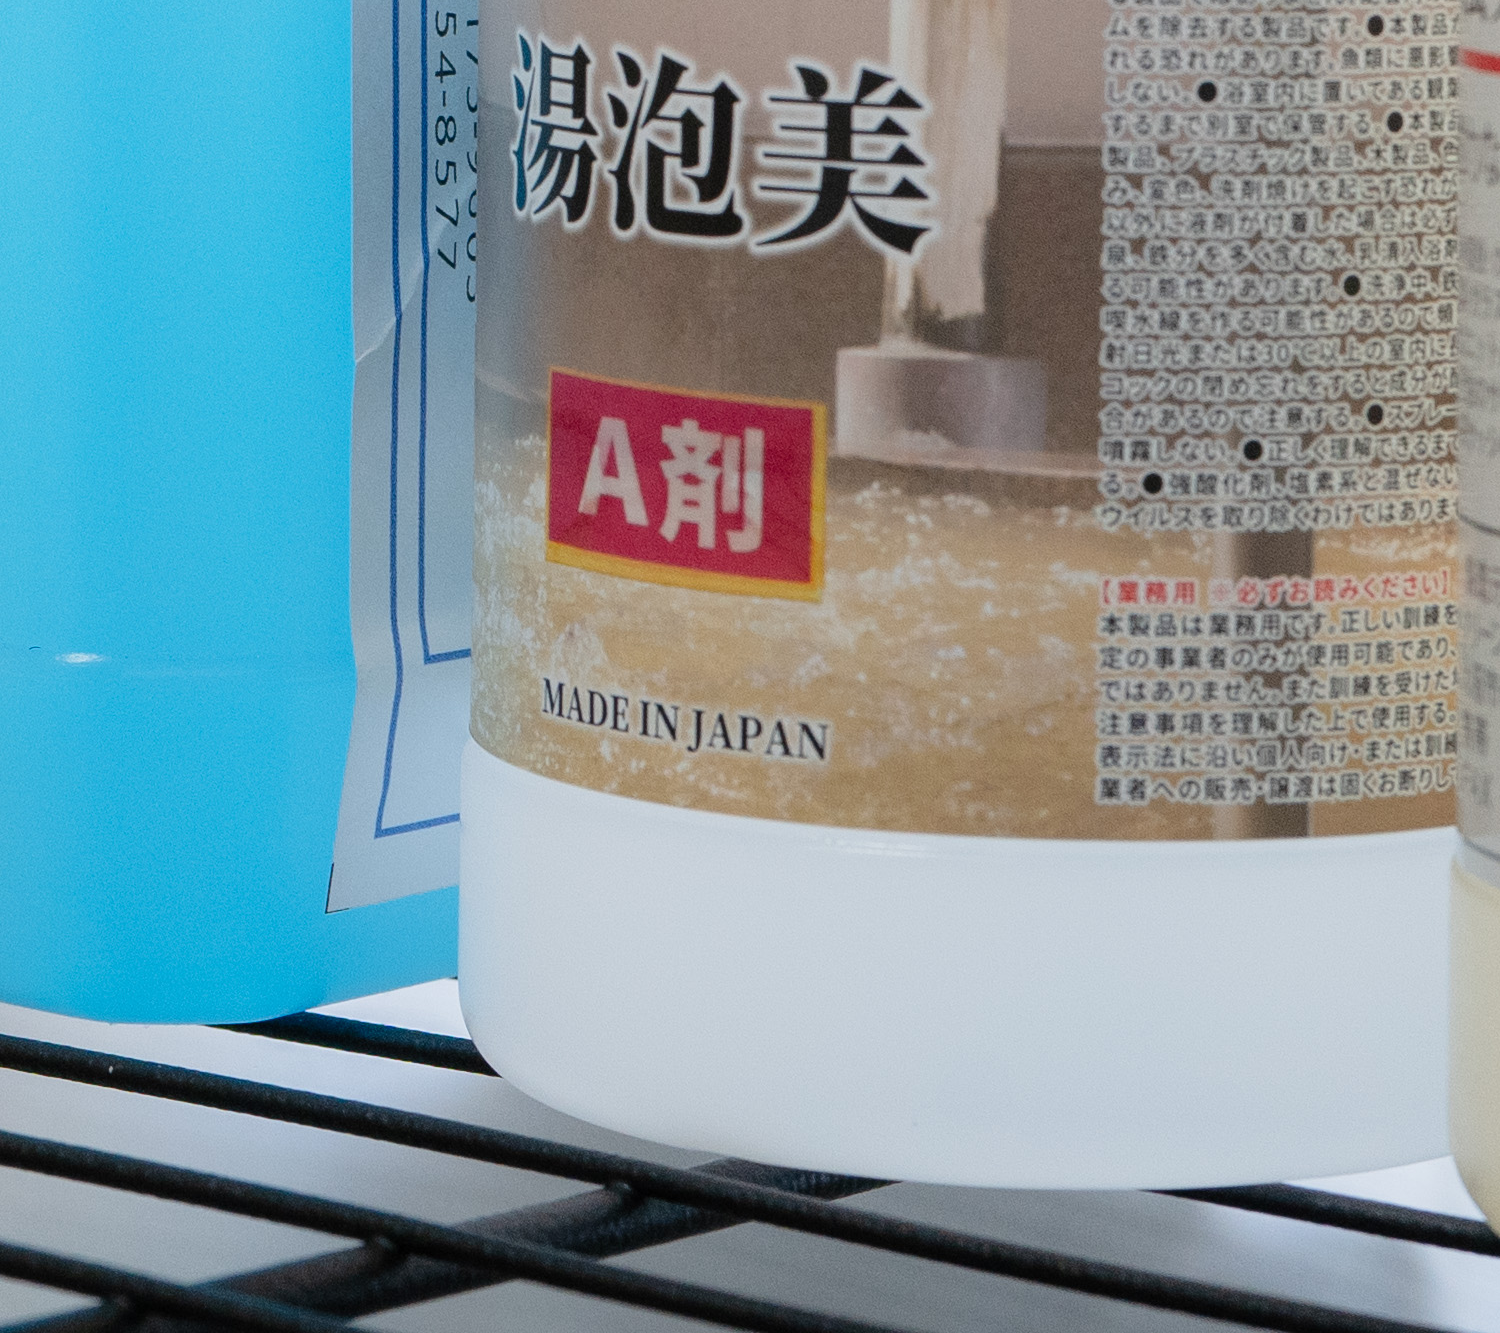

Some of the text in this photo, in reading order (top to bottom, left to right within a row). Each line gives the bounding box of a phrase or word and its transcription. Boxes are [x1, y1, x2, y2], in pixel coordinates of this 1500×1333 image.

[512, 32, 933, 255] 湯泡美
[577, 415, 765, 553] A剤
[541, 677, 829, 761] MADE IN JAPAN
[1100, 669, 1457, 703] ではありません。また訓練を受けた
